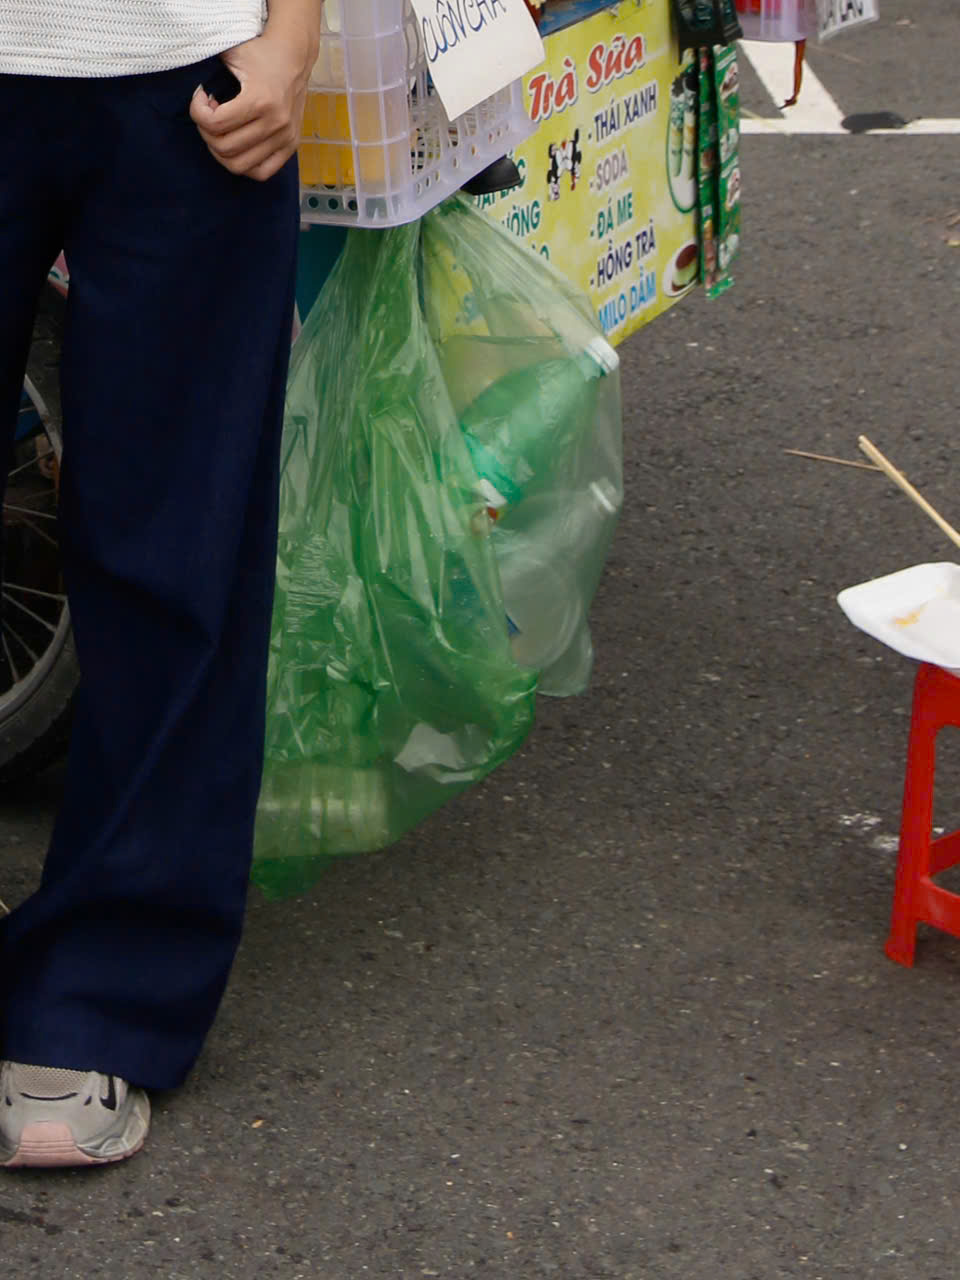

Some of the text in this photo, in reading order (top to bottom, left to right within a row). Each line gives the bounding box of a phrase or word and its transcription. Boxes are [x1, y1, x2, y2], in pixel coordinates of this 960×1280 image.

[529, 35, 643, 121] Trà Sữa
[594, 83, 657, 142] THÁI XANH
[596, 149, 628, 191] SODA
[597, 191, 632, 239] ĐÁ ME
[597, 218, 656, 288] HỒNG TRÀ
[599, 293, 626, 336] MILO
